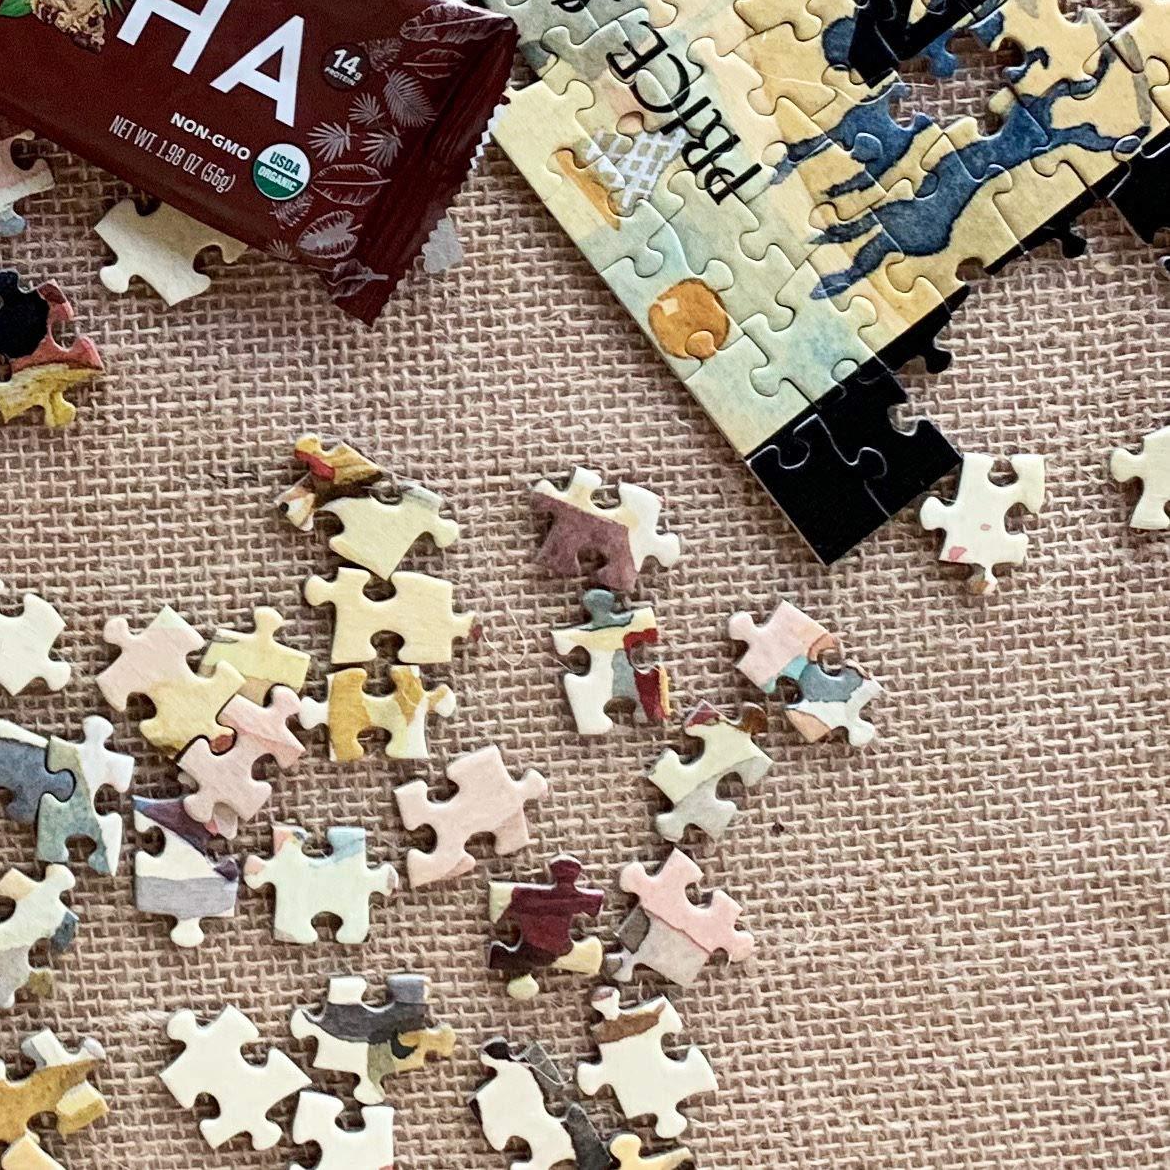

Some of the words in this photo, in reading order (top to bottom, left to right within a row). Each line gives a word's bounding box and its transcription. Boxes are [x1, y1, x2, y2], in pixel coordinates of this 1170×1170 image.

[170, 112, 251, 161] NON-GMO
[606, 20, 762, 206] PRICE
[108, 114, 138, 141] NET
[133, 126, 158, 153] WT.
[156, 139, 186, 167] 1.98
[183, 152, 204, 176] OZ
[200, 161, 237, 194] (56g)
[257, 165, 299, 192] ORGANIC
[269, 151, 301, 176] USDA
